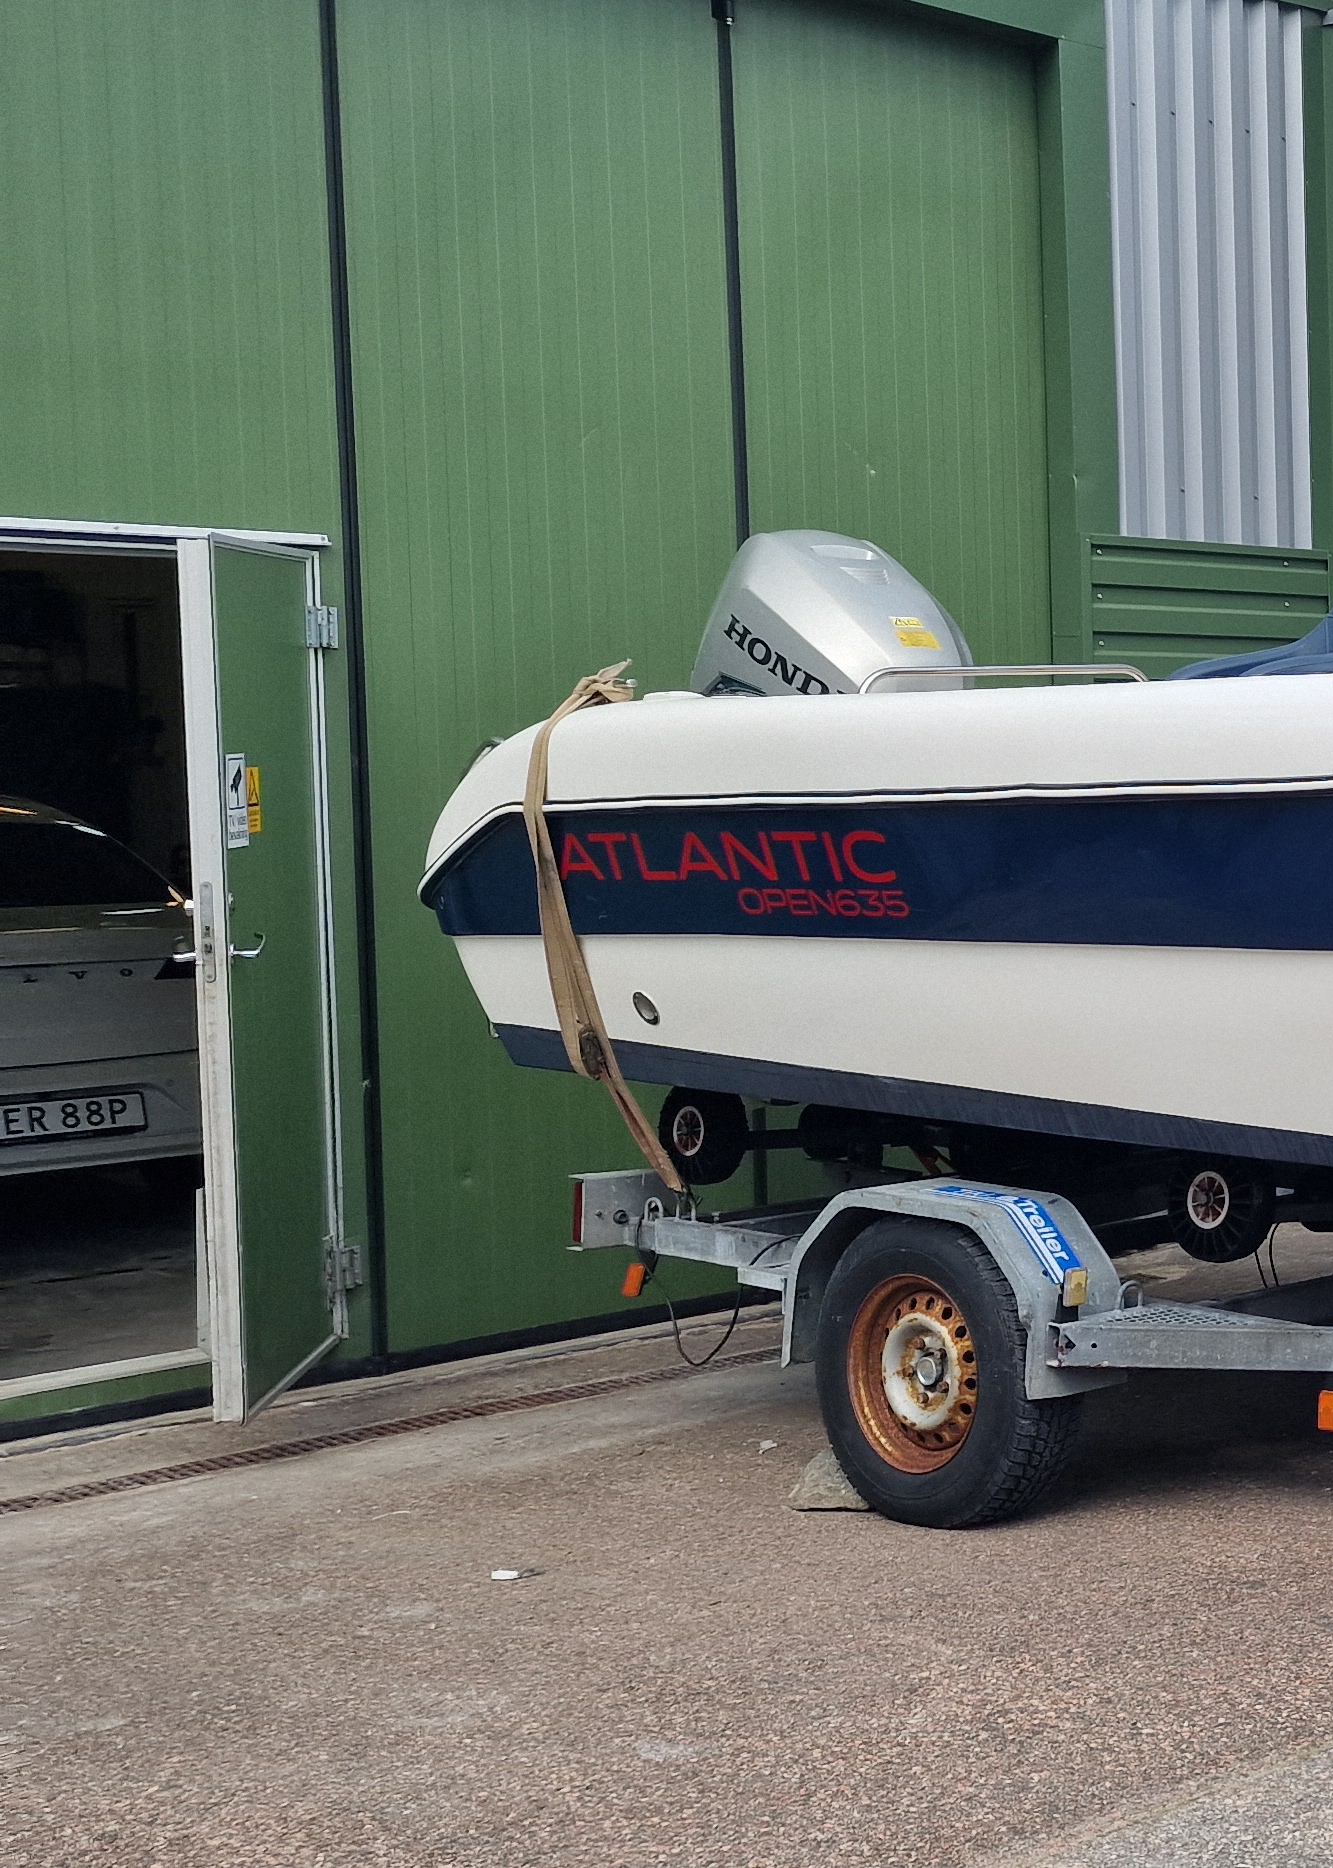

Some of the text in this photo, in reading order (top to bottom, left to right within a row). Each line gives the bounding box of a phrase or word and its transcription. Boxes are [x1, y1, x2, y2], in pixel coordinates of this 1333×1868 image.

[724, 614, 848, 695] HOND
[561, 831, 896, 883] ATLANTIC
[738, 887, 910, 918] OPEN635
[2, 1098, 127, 1135] ER 88P
